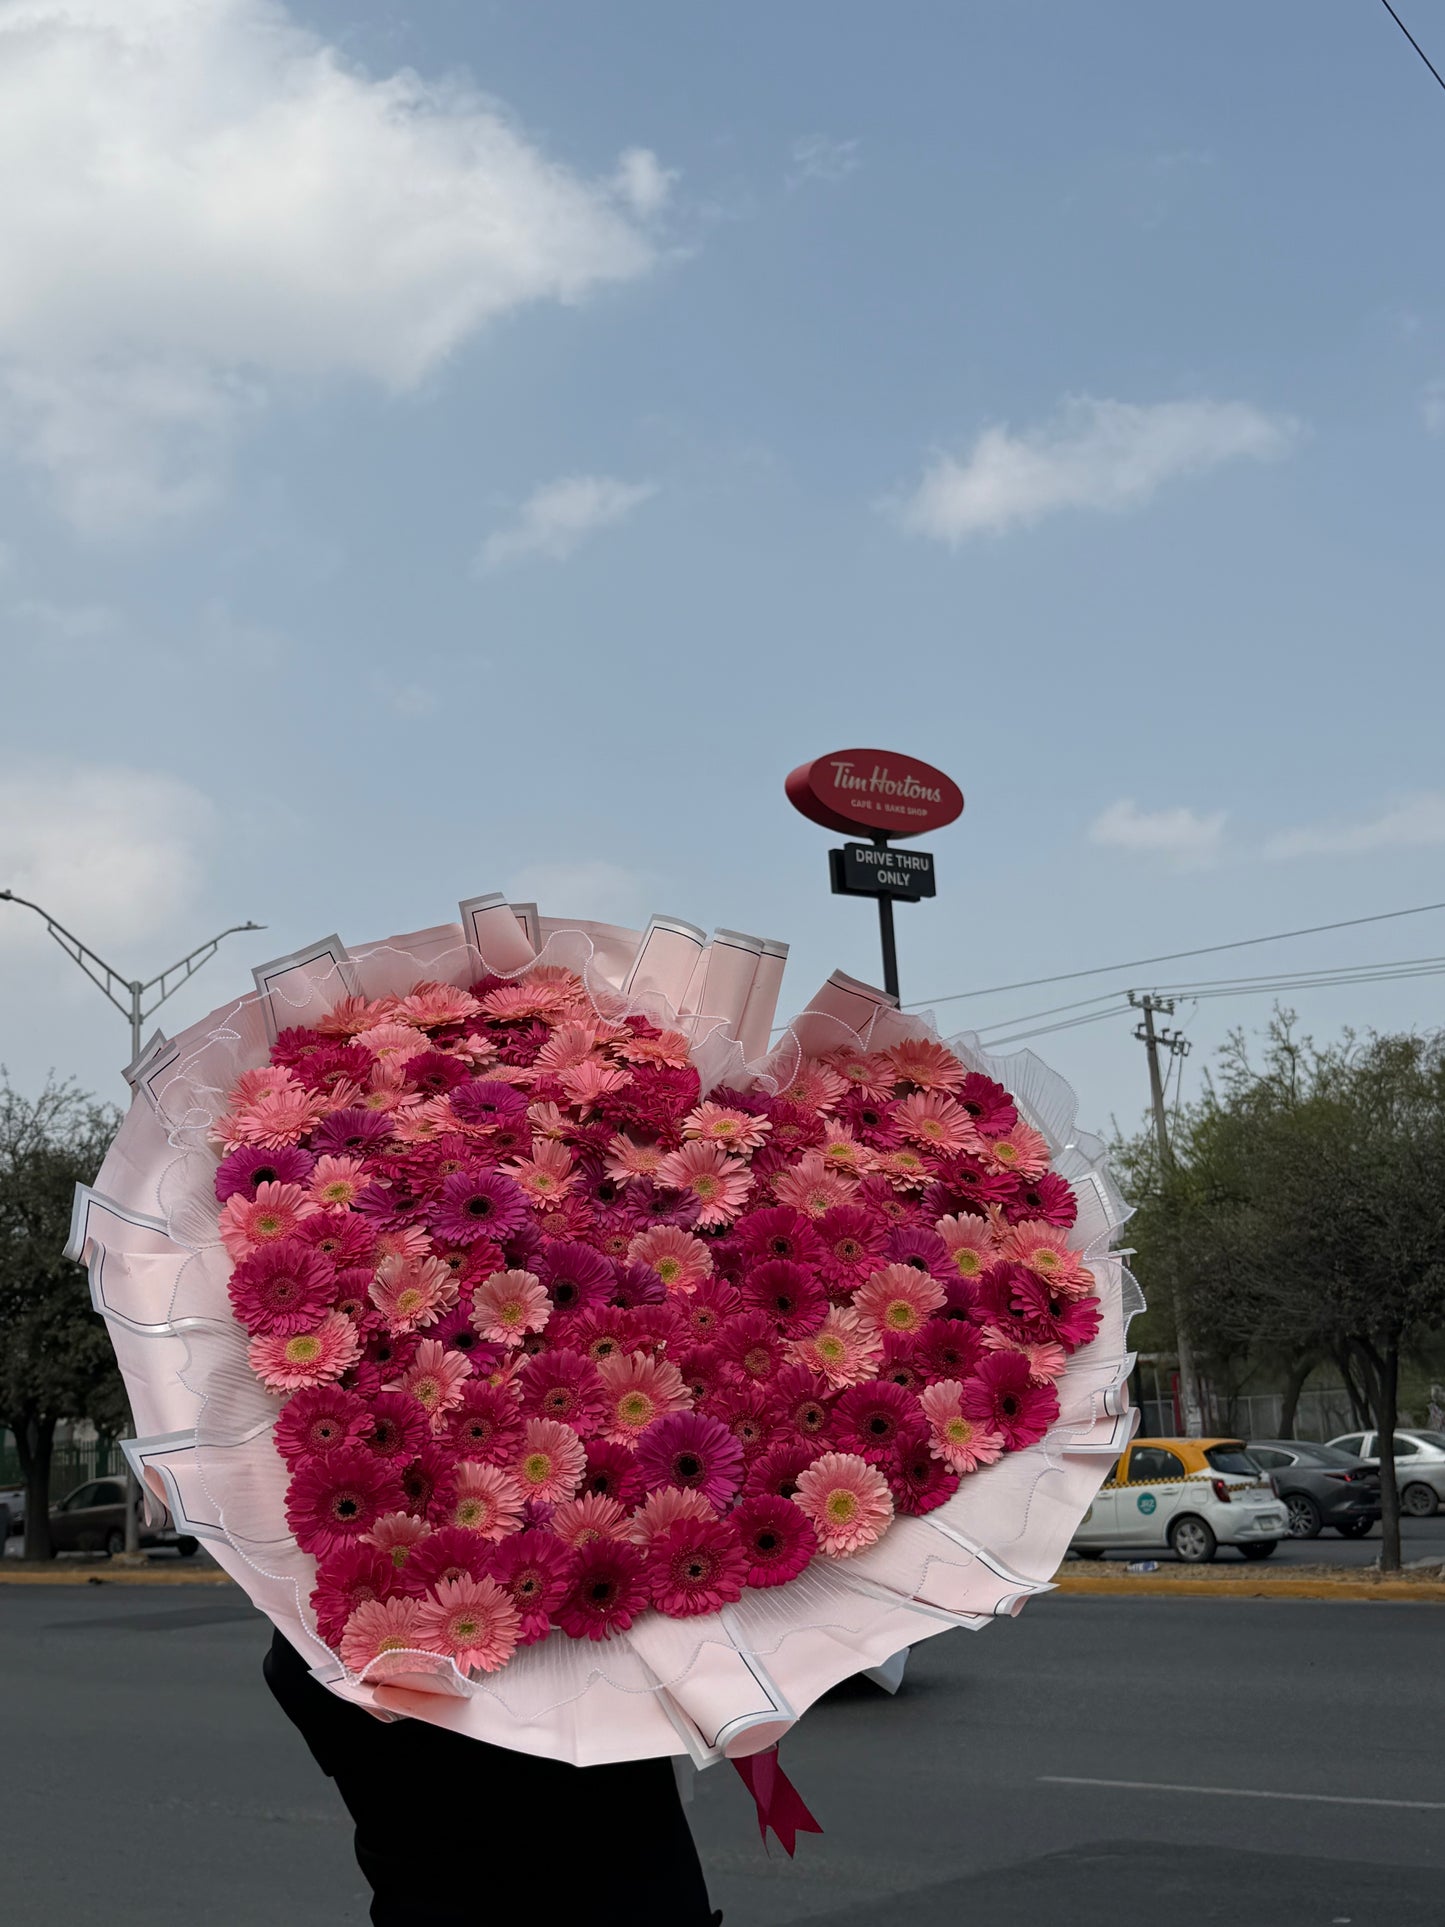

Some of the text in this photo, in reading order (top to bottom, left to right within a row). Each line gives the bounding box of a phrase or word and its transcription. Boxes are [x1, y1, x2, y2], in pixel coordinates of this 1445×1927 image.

[830, 761, 941, 802] Tim Hortons
[876, 801, 882, 811] &
[885, 803, 905, 814] BAKE
[907, 807, 928, 817] SHOP
[855, 849, 929, 870] DRIVE THRU
[877, 870, 910, 886] ONLY
